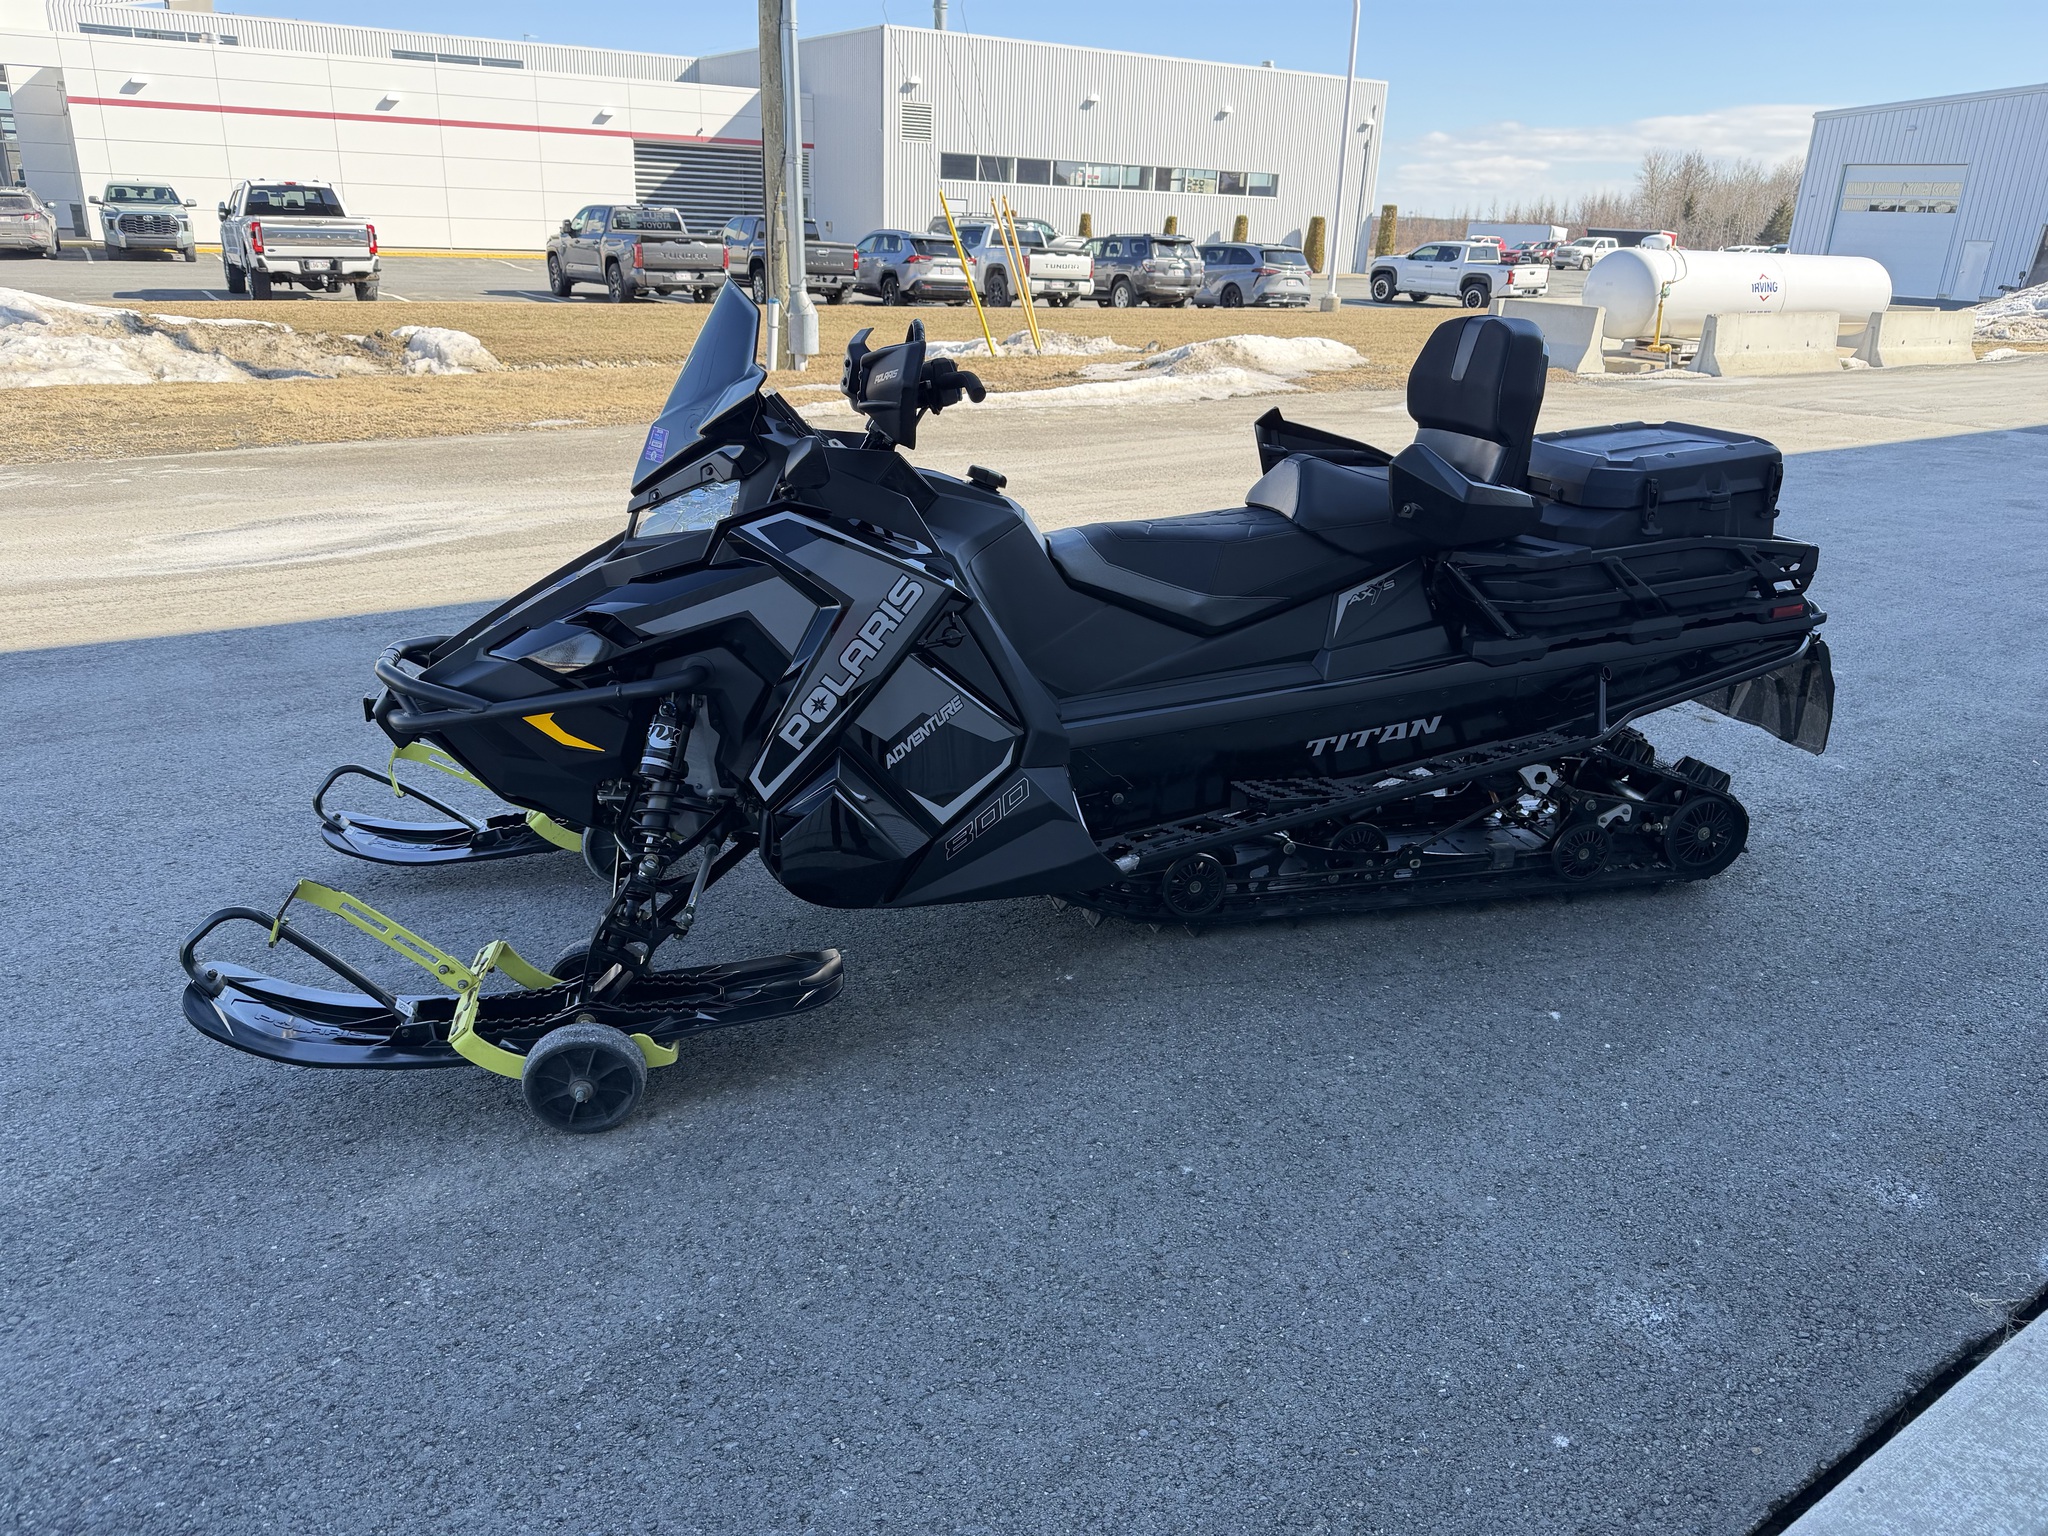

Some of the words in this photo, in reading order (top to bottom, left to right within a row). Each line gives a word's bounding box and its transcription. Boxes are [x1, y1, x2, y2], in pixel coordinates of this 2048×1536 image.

[642, 222, 672, 230] TOYOTA
[661, 252, 708, 260] TUNDRA
[1751, 282, 1778, 293] IRVING
[874, 369, 899, 384] POLARIS
[778, 573, 925, 750] POLARIS
[885, 694, 964, 770] ADVENTURE
[1306, 715, 1442, 757] TITAN
[945, 778, 1030, 860] 800
